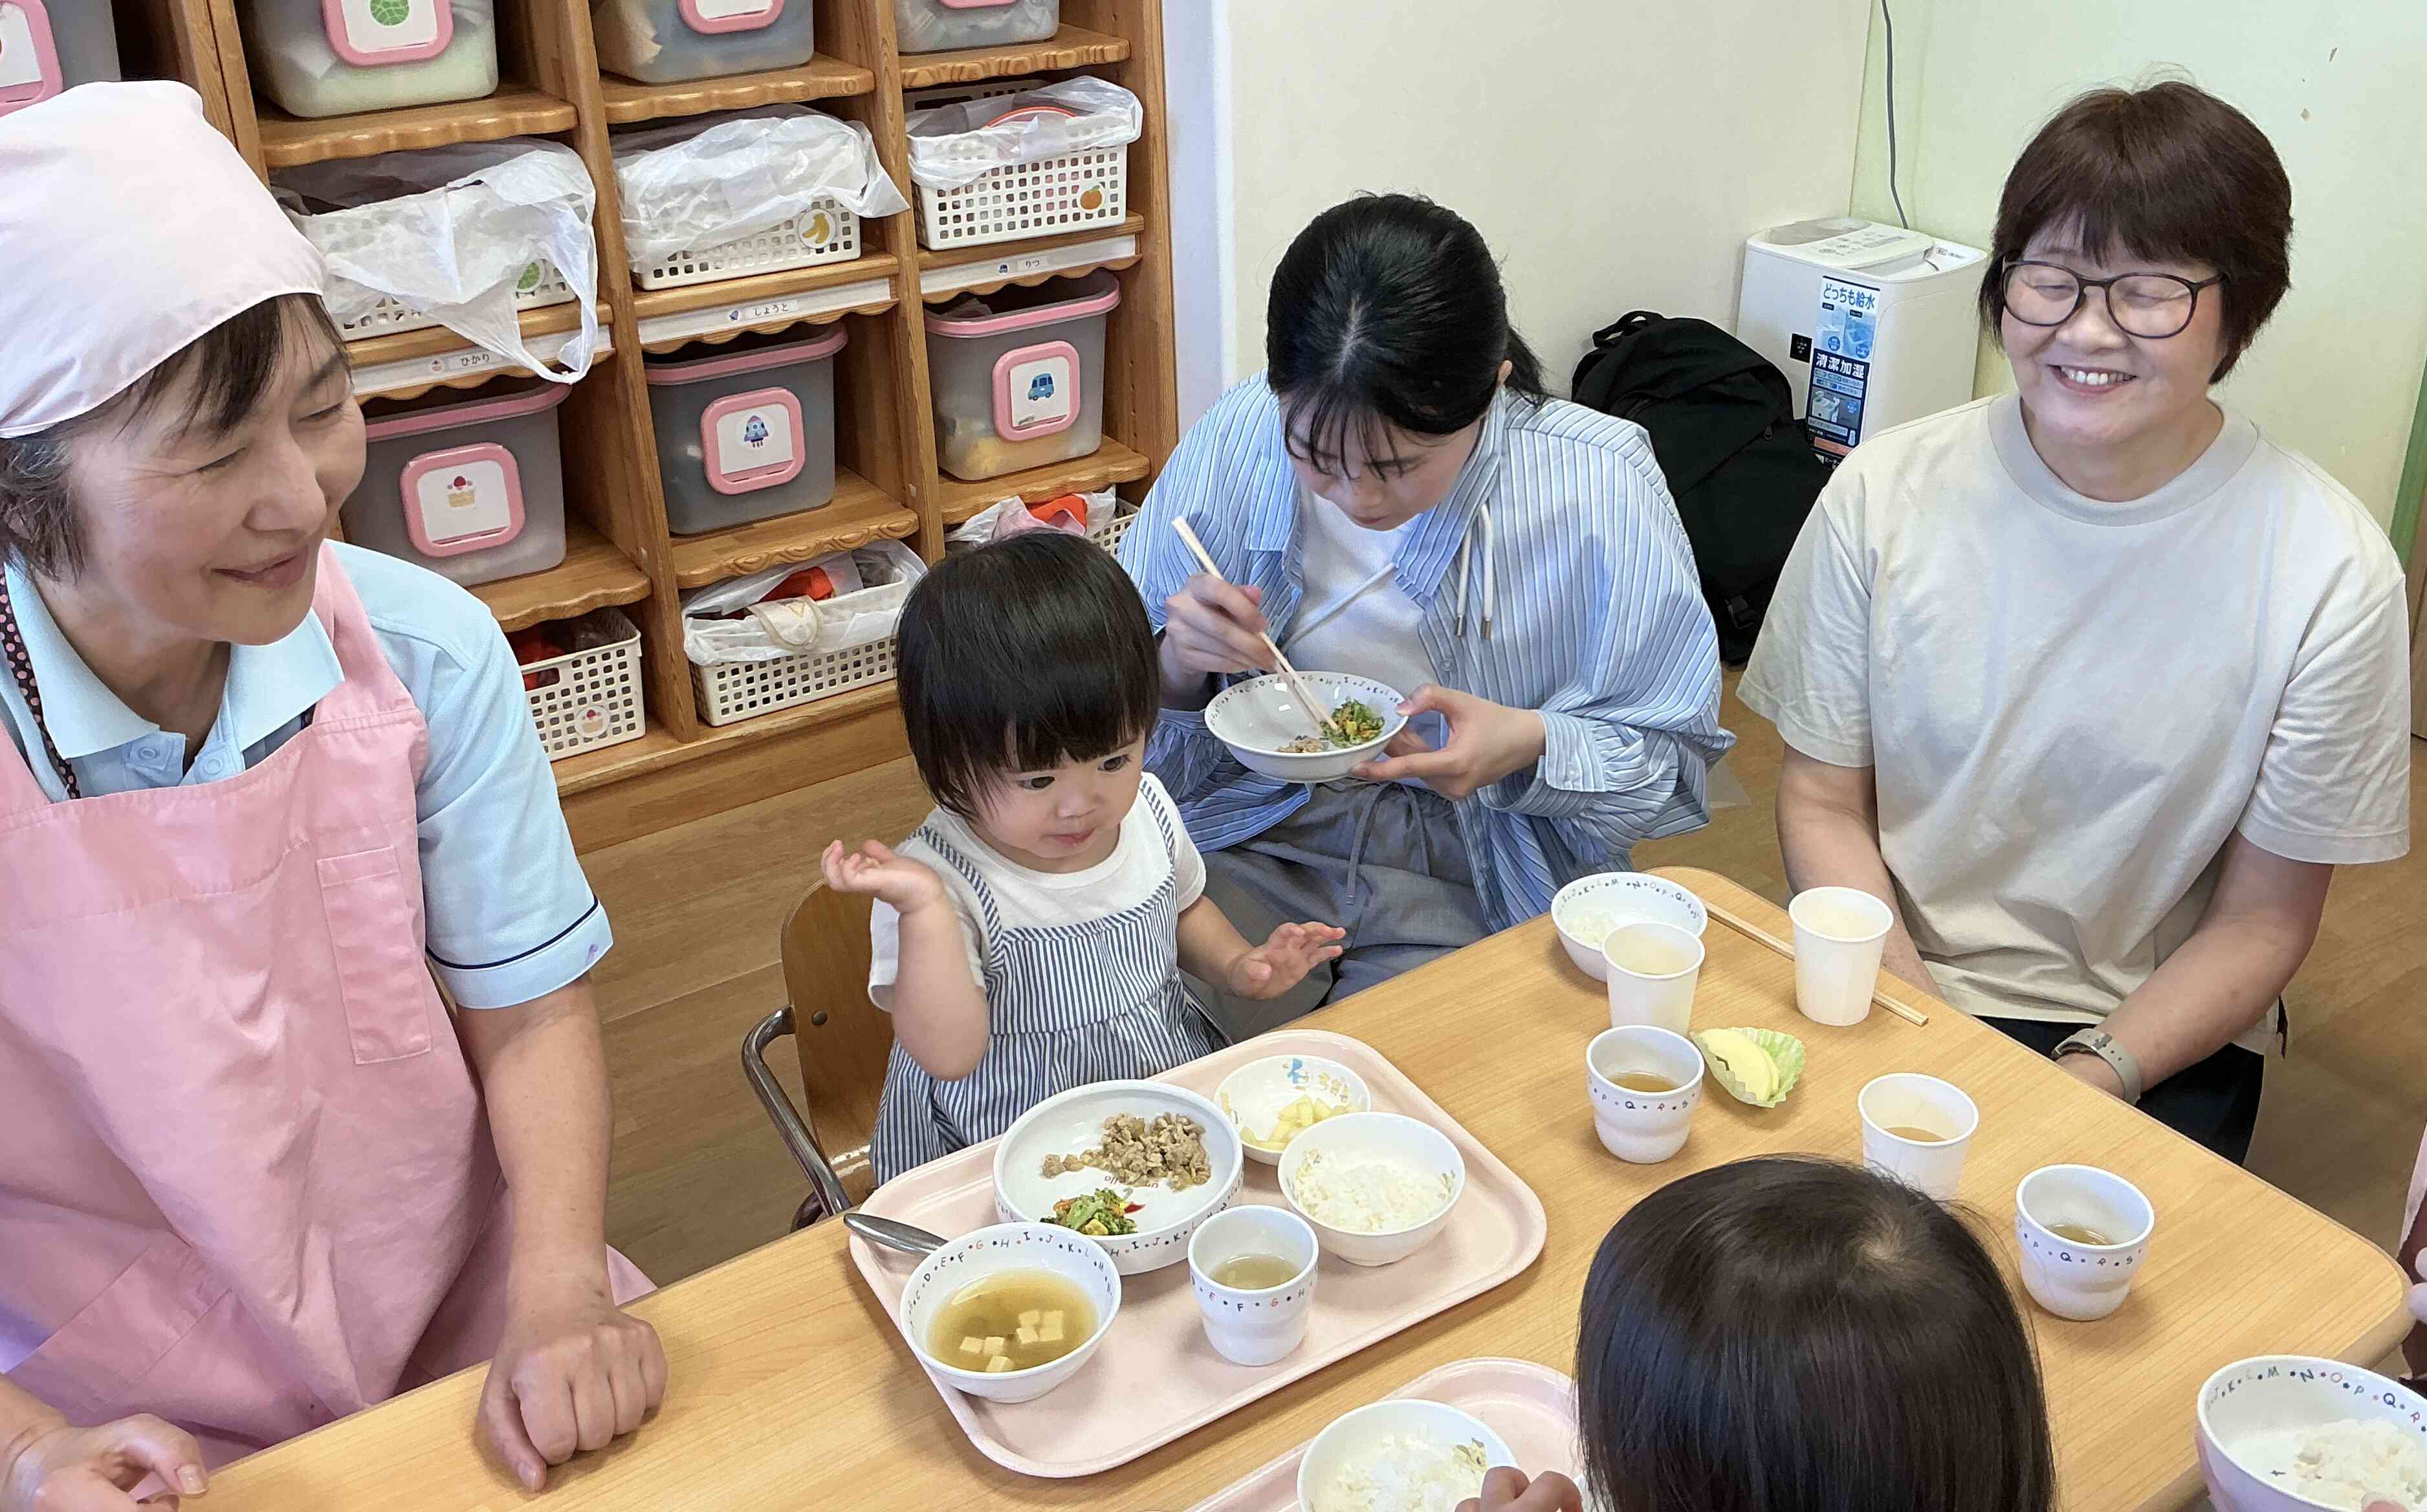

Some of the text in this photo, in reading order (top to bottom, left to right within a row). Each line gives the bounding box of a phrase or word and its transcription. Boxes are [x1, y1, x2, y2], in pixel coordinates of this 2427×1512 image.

[1026, 260, 1040, 269] りつ
[1823, 283, 1875, 310] どっちも給水
[754, 303, 787, 316] しょうと
[461, 353, 490, 367] ひかり
[1816, 353, 1865, 379] 清潔加湿
[1625, 1101, 1636, 1109] Q
[2060, 1252, 2072, 1262] Q
[2300, 1368, 2314, 1383] N
[2331, 1372, 2343, 1383] O
[2383, 1392, 2396, 1408] Q
